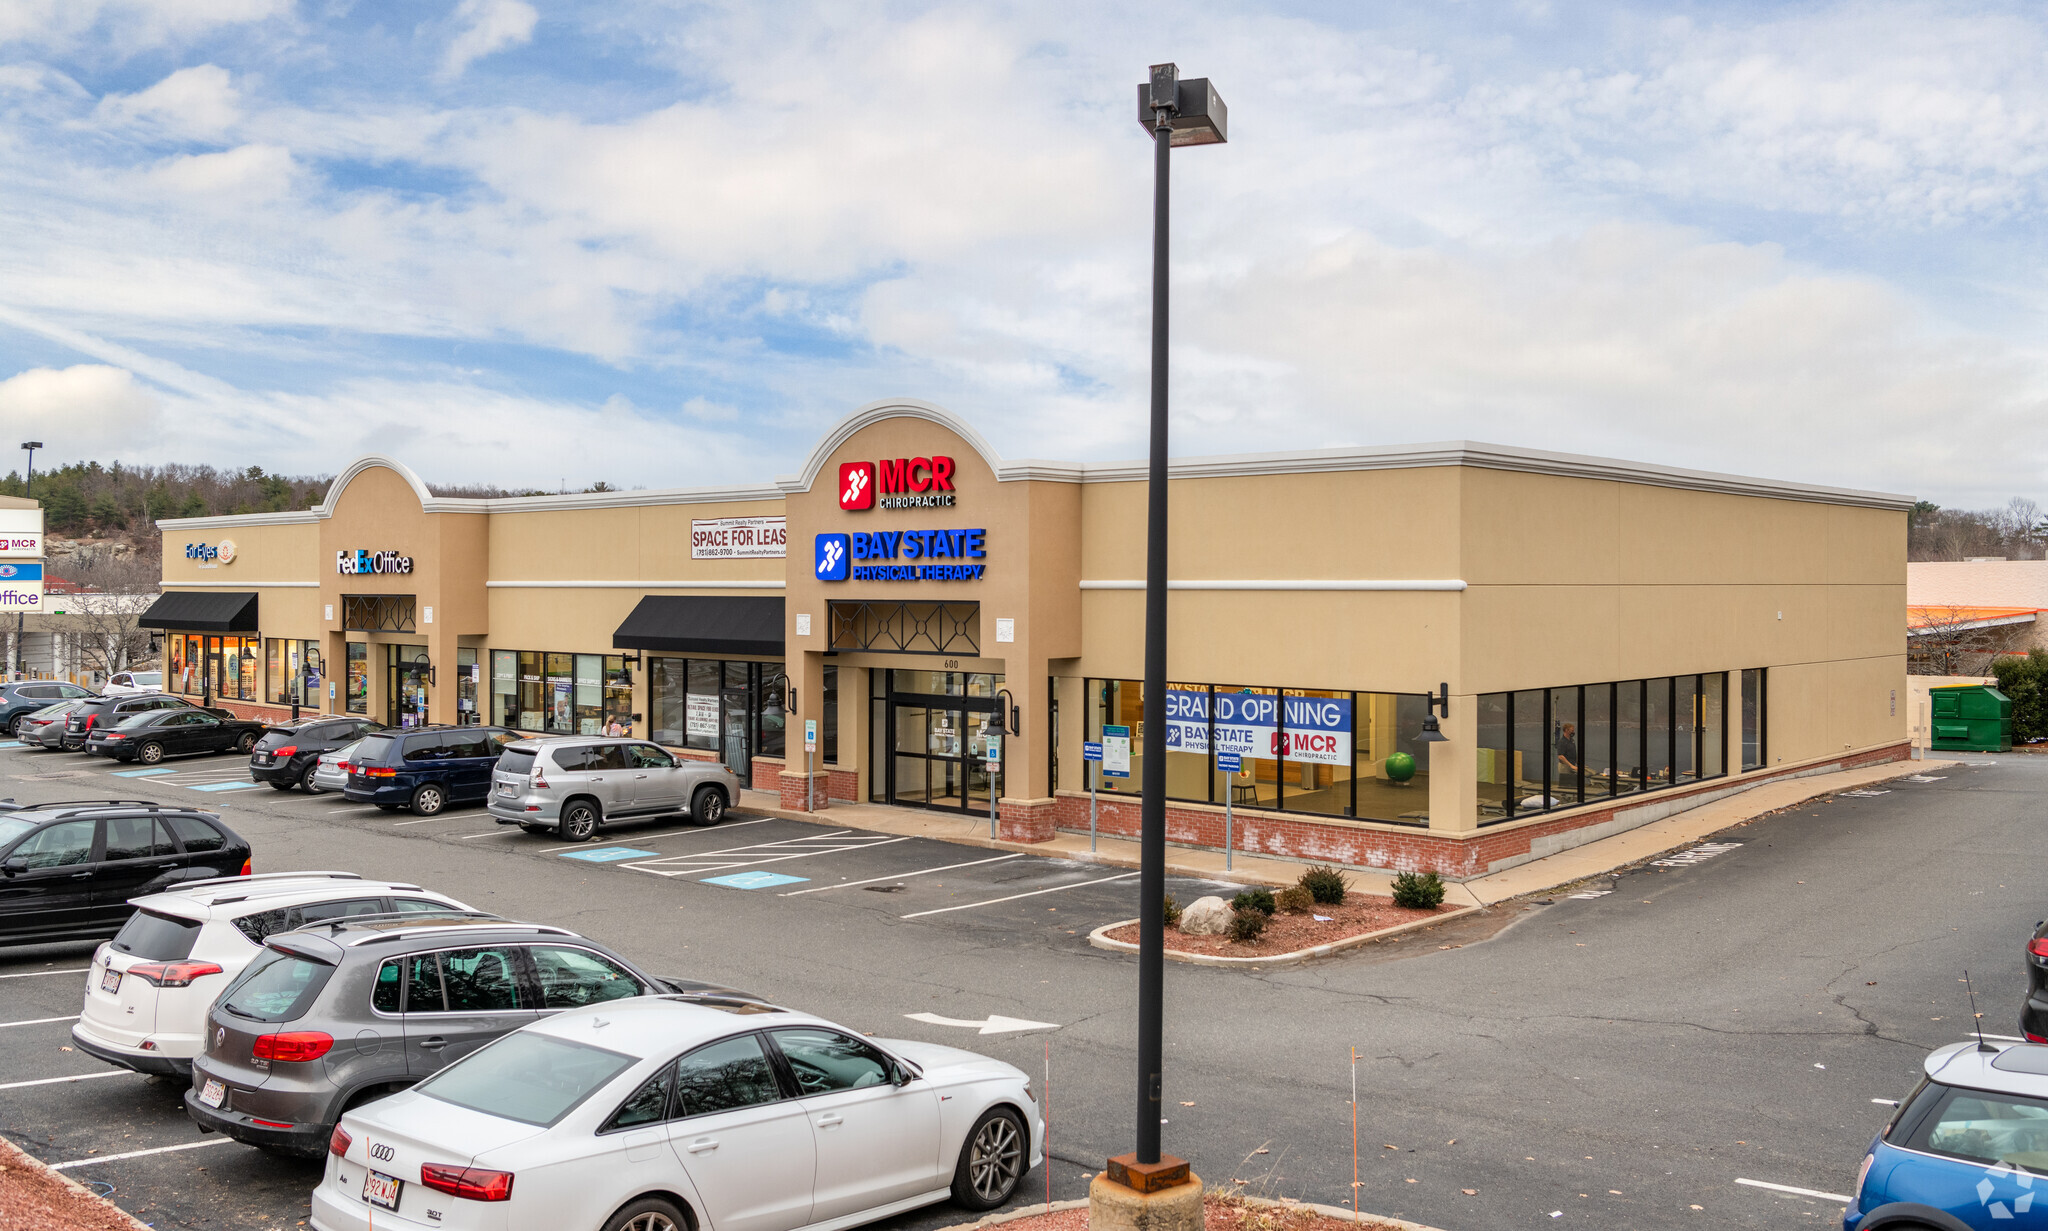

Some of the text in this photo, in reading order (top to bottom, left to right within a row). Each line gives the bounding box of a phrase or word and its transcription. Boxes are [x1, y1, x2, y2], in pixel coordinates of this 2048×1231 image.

[879, 455, 956, 494] MCR
[880, 495, 953, 509] CHIROPRACTIC
[11, 539, 36, 548] MCR
[693, 528, 786, 547] SPACE FOR LEAS
[853, 528, 986, 559] BAY STATE
[185, 543, 218, 562] For Eyes
[336, 549, 411, 574] FedEx Office
[853, 564, 984, 581] PHYSICAL THERAPY
[0, 589, 39, 605] ffice
[944, 660, 959, 669] 600
[1166, 694, 1234, 720] GRAND
[1185, 726, 1254, 743] BAY STATE
[1294, 733, 1337, 753] MCR
[1185, 741, 1254, 754] PHYSICL THERAPY
[1294, 752, 1338, 761] CHIROPRACTIC
